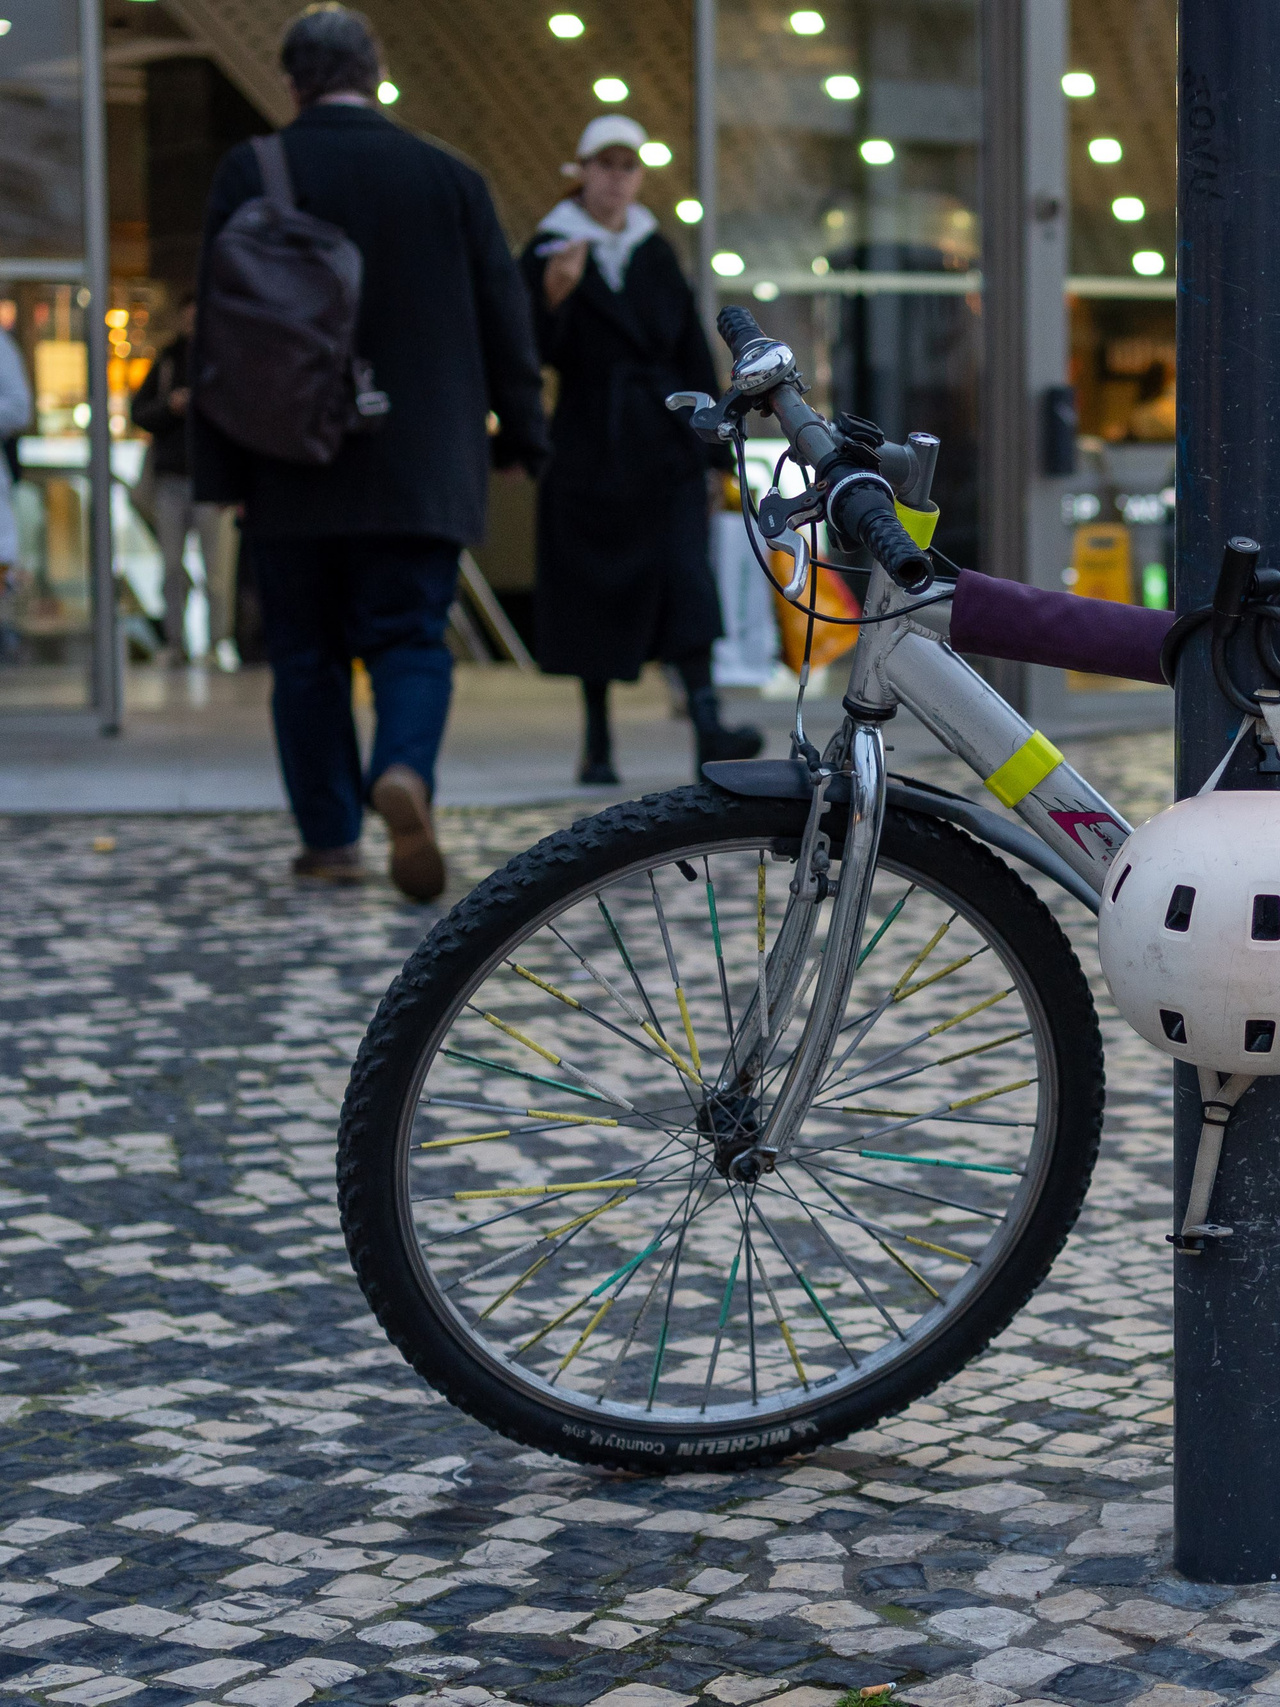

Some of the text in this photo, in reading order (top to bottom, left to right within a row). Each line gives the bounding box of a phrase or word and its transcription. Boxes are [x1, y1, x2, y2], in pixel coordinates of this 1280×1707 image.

[562, 1424, 790, 1455] MICHELIN Country style
